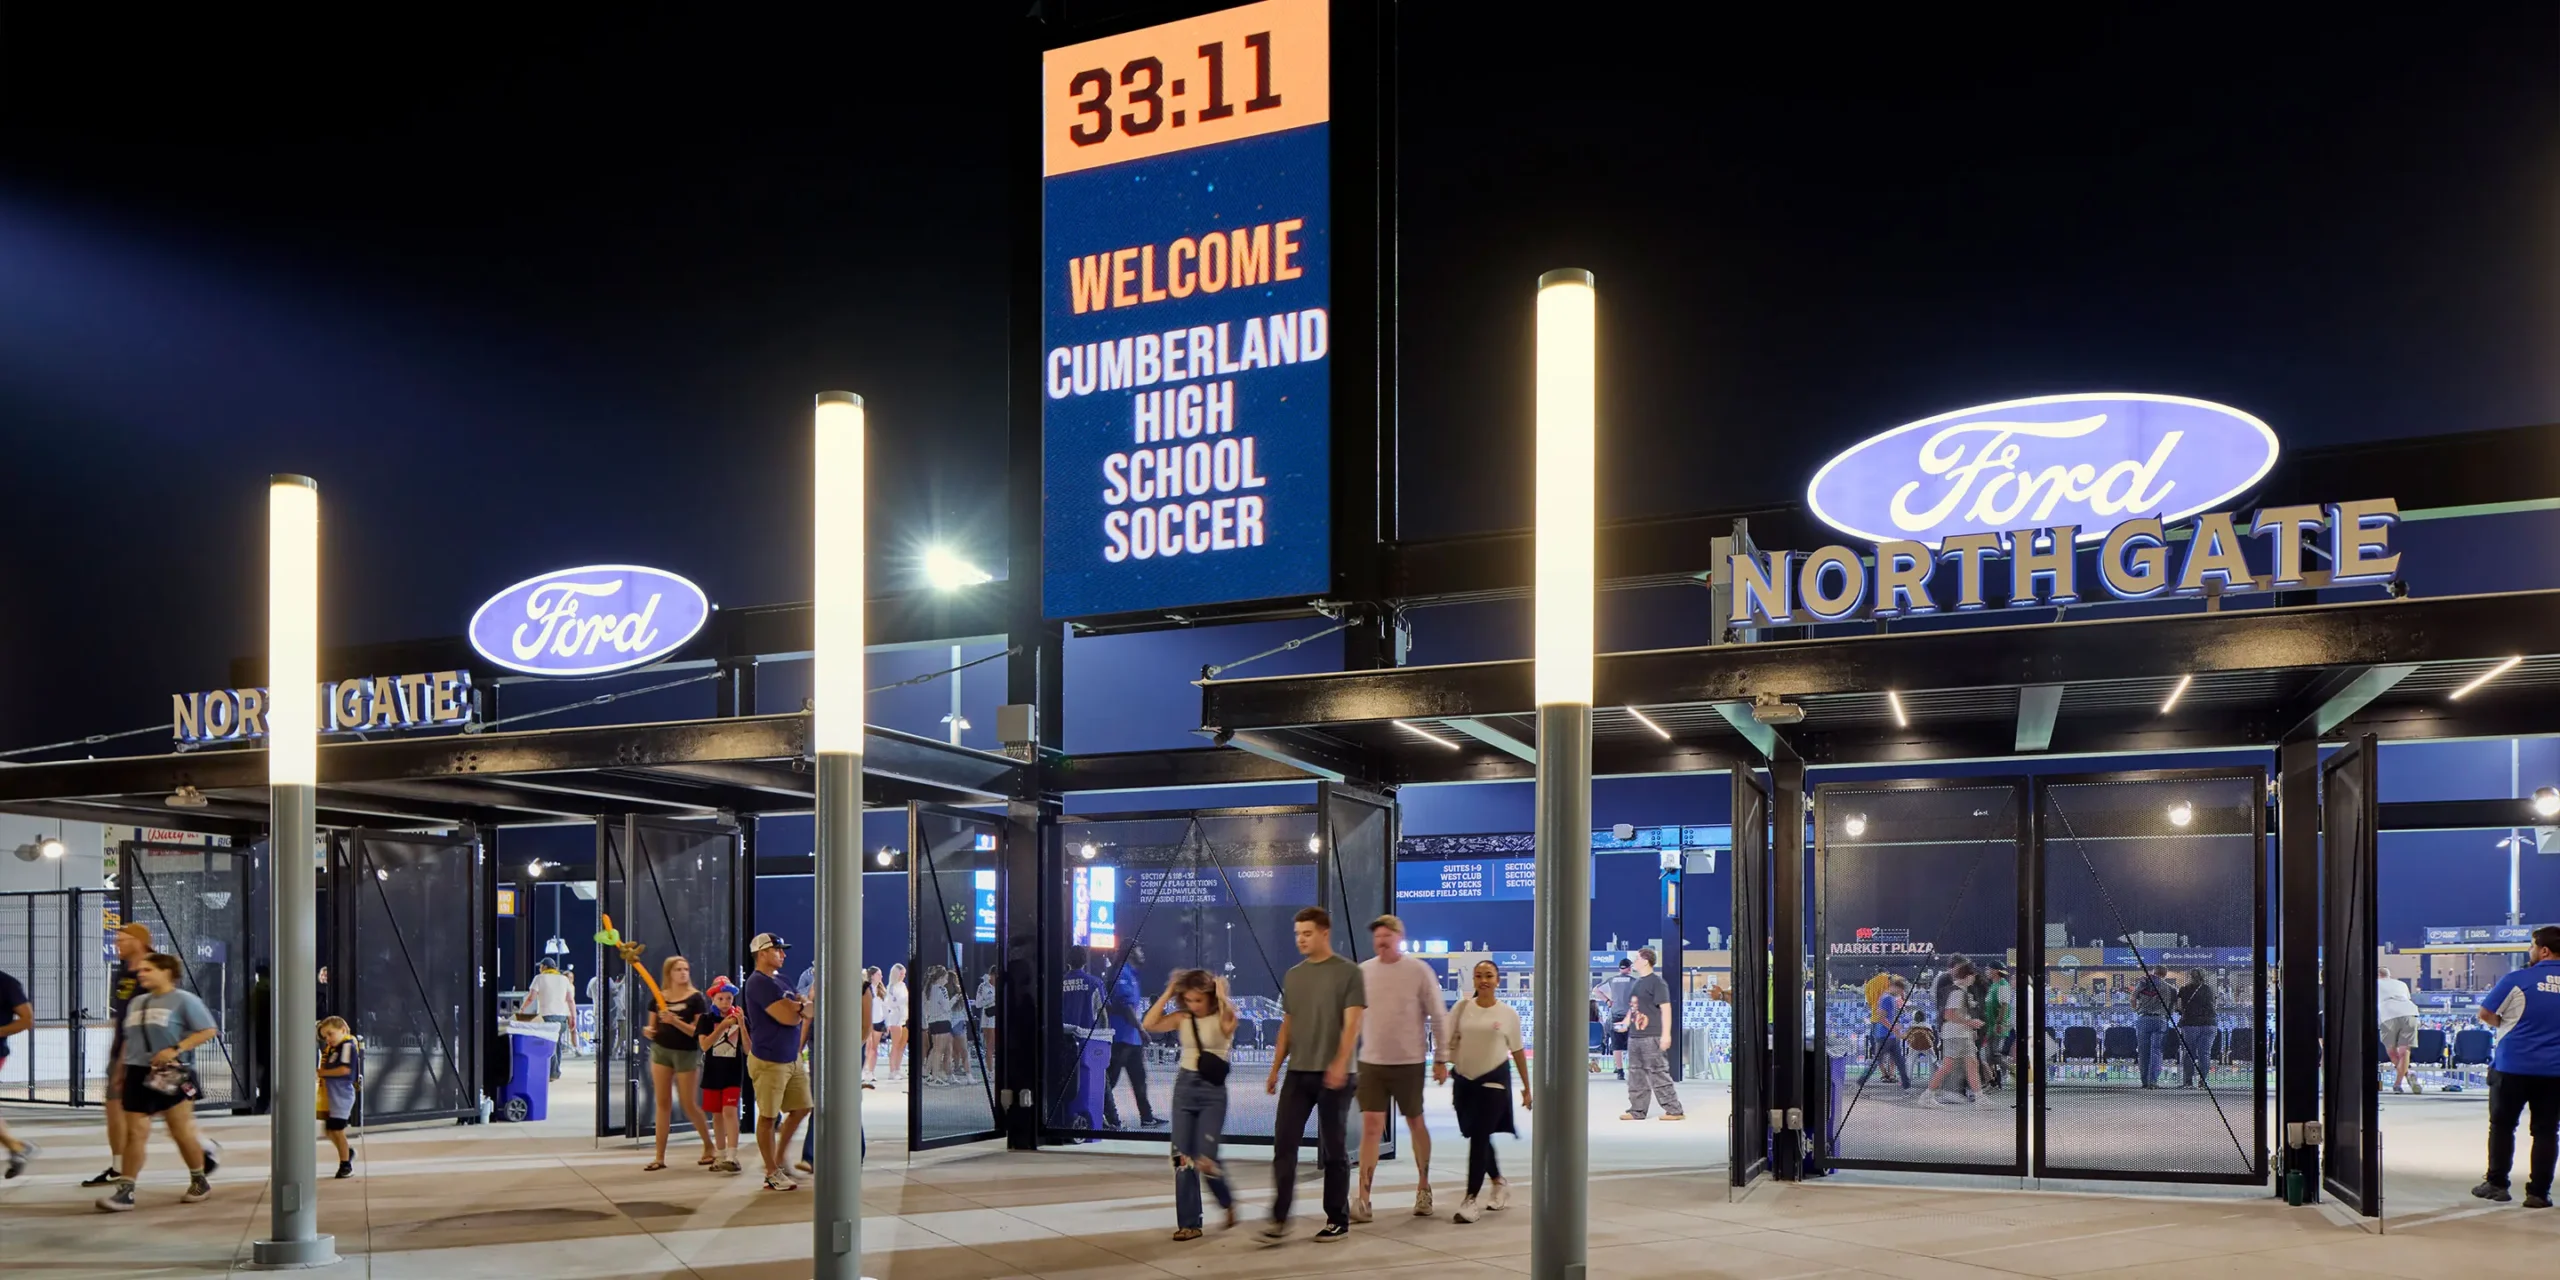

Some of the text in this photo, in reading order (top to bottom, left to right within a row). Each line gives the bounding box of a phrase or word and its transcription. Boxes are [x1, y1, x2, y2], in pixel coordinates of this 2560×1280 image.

[1069, 30, 1282, 147] 33:11
[1068, 218, 1303, 315] WELCOME
[1047, 308, 1328, 400] CUMBERLAND
[1134, 380, 1234, 444] HIGH
[1103, 436, 1266, 505] SCHOOL
[1889, 413, 2185, 532] Ford
[1103, 495, 1264, 563] SOCCER
[1726, 496, 2403, 627] NORTH GATE
[511, 579, 662, 661] Ford
[336, 669, 468, 730] GATE
[1140, 872, 1172, 880] SECTIOS
[1140, 888, 1172, 896] MIDFELD
[1436, 889, 1458, 898] FIELD
[1458, 889, 1482, 897] SEATS
[1440, 872, 1482, 881] WEST CLUB
[1441, 880, 1482, 889] SKY DECKS
[1443, 864, 1482, 872] SUITES 1-9
[1830, 942, 1936, 954] MARKET PLAZA
[1063, 984, 1089, 992] ERVICES
